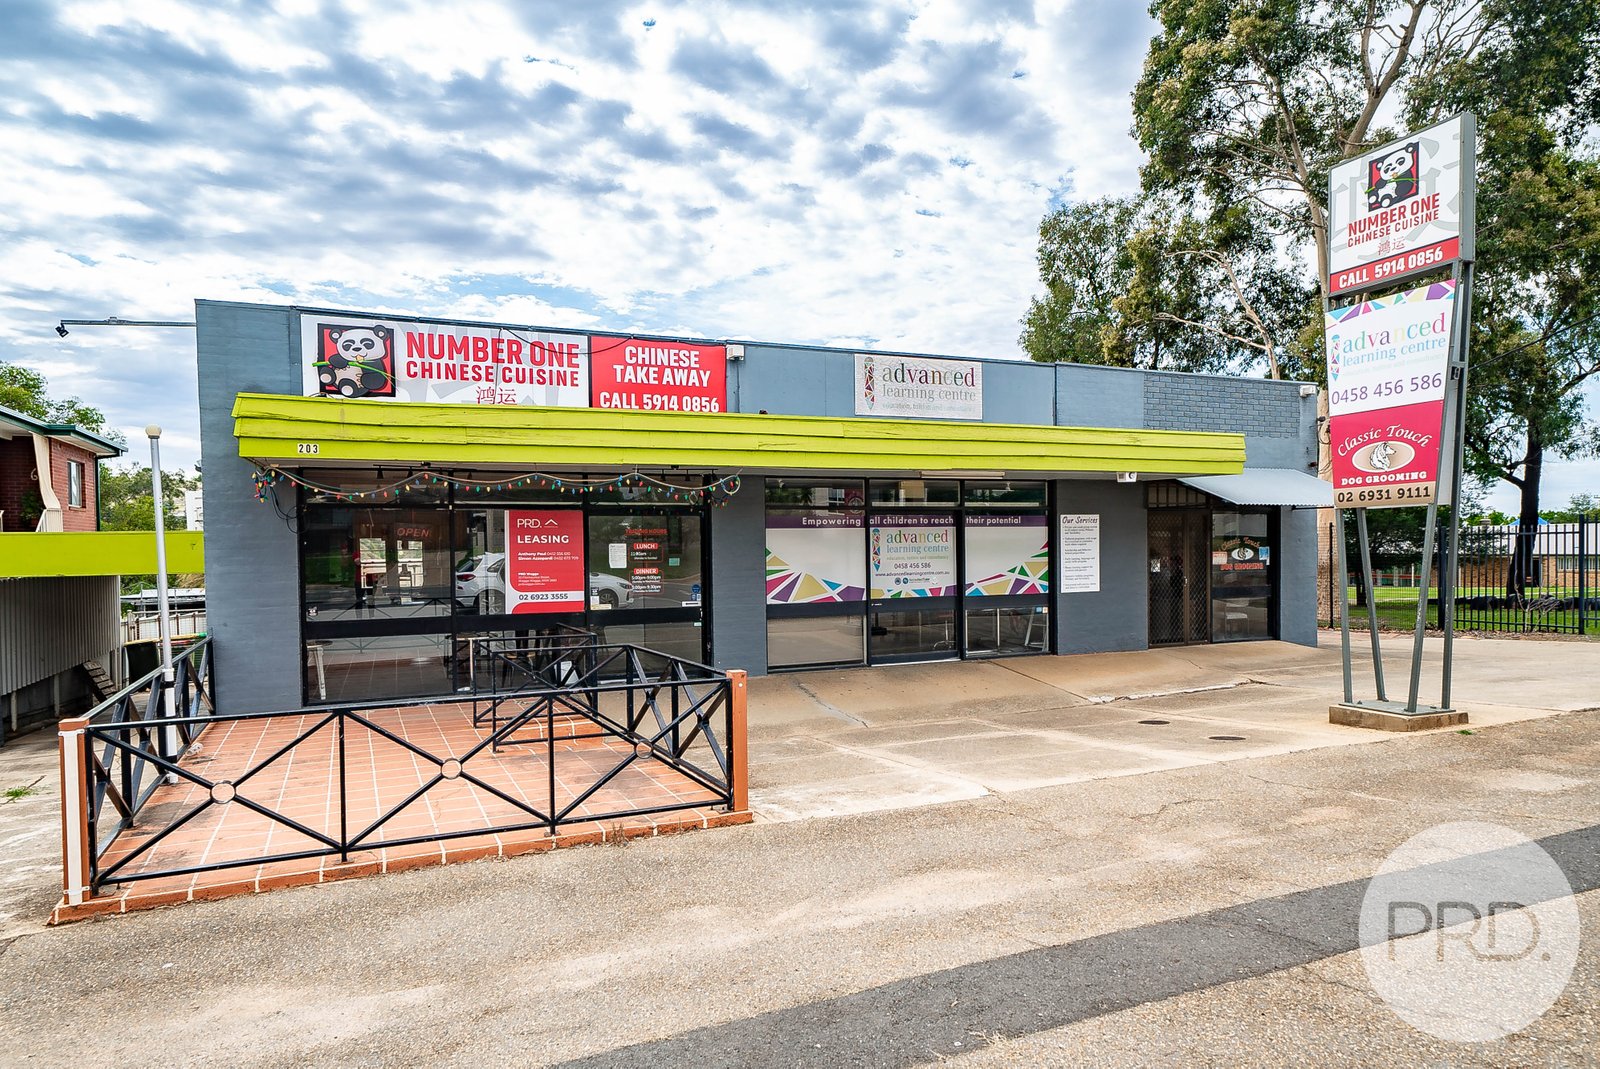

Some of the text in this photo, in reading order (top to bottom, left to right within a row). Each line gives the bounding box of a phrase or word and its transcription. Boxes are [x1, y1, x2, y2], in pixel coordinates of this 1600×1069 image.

[1347, 193, 1440, 238] NUMBER ONE
[1347, 210, 1440, 247] CHINESE CUISINE
[1338, 246, 1443, 289] CALL 5914 0856
[1342, 312, 1446, 354] advanced
[406, 331, 580, 369] NUMBER ONE
[624, 345, 700, 368] CHINESE
[1342, 346, 1396, 367] learning
[1401, 337, 1446, 356] centre
[406, 361, 580, 388] CHINESE CUISINE
[613, 364, 710, 388] TAKE AWAY
[882, 363, 976, 388] advanced
[882, 384, 976, 402] learning centre
[1331, 373, 1442, 405] 0458 456 586
[599, 391, 720, 413] CALL 5914 0856
[298, 443, 318, 454] 203
[1337, 424, 1433, 457] Classic Touch
[1341, 471, 1427, 486] DOG GROOMING
[1337, 486, 1431, 503] 02 6931 9111
[802, 515, 1022, 527] Empowering all children to reach their potential
[1062, 516, 1098, 524] Our Services
[397, 527, 430, 537] OPEN
[517, 535, 569, 544] LEASING
[886, 530, 949, 544] advanced
[886, 544, 949, 554] learning centre
